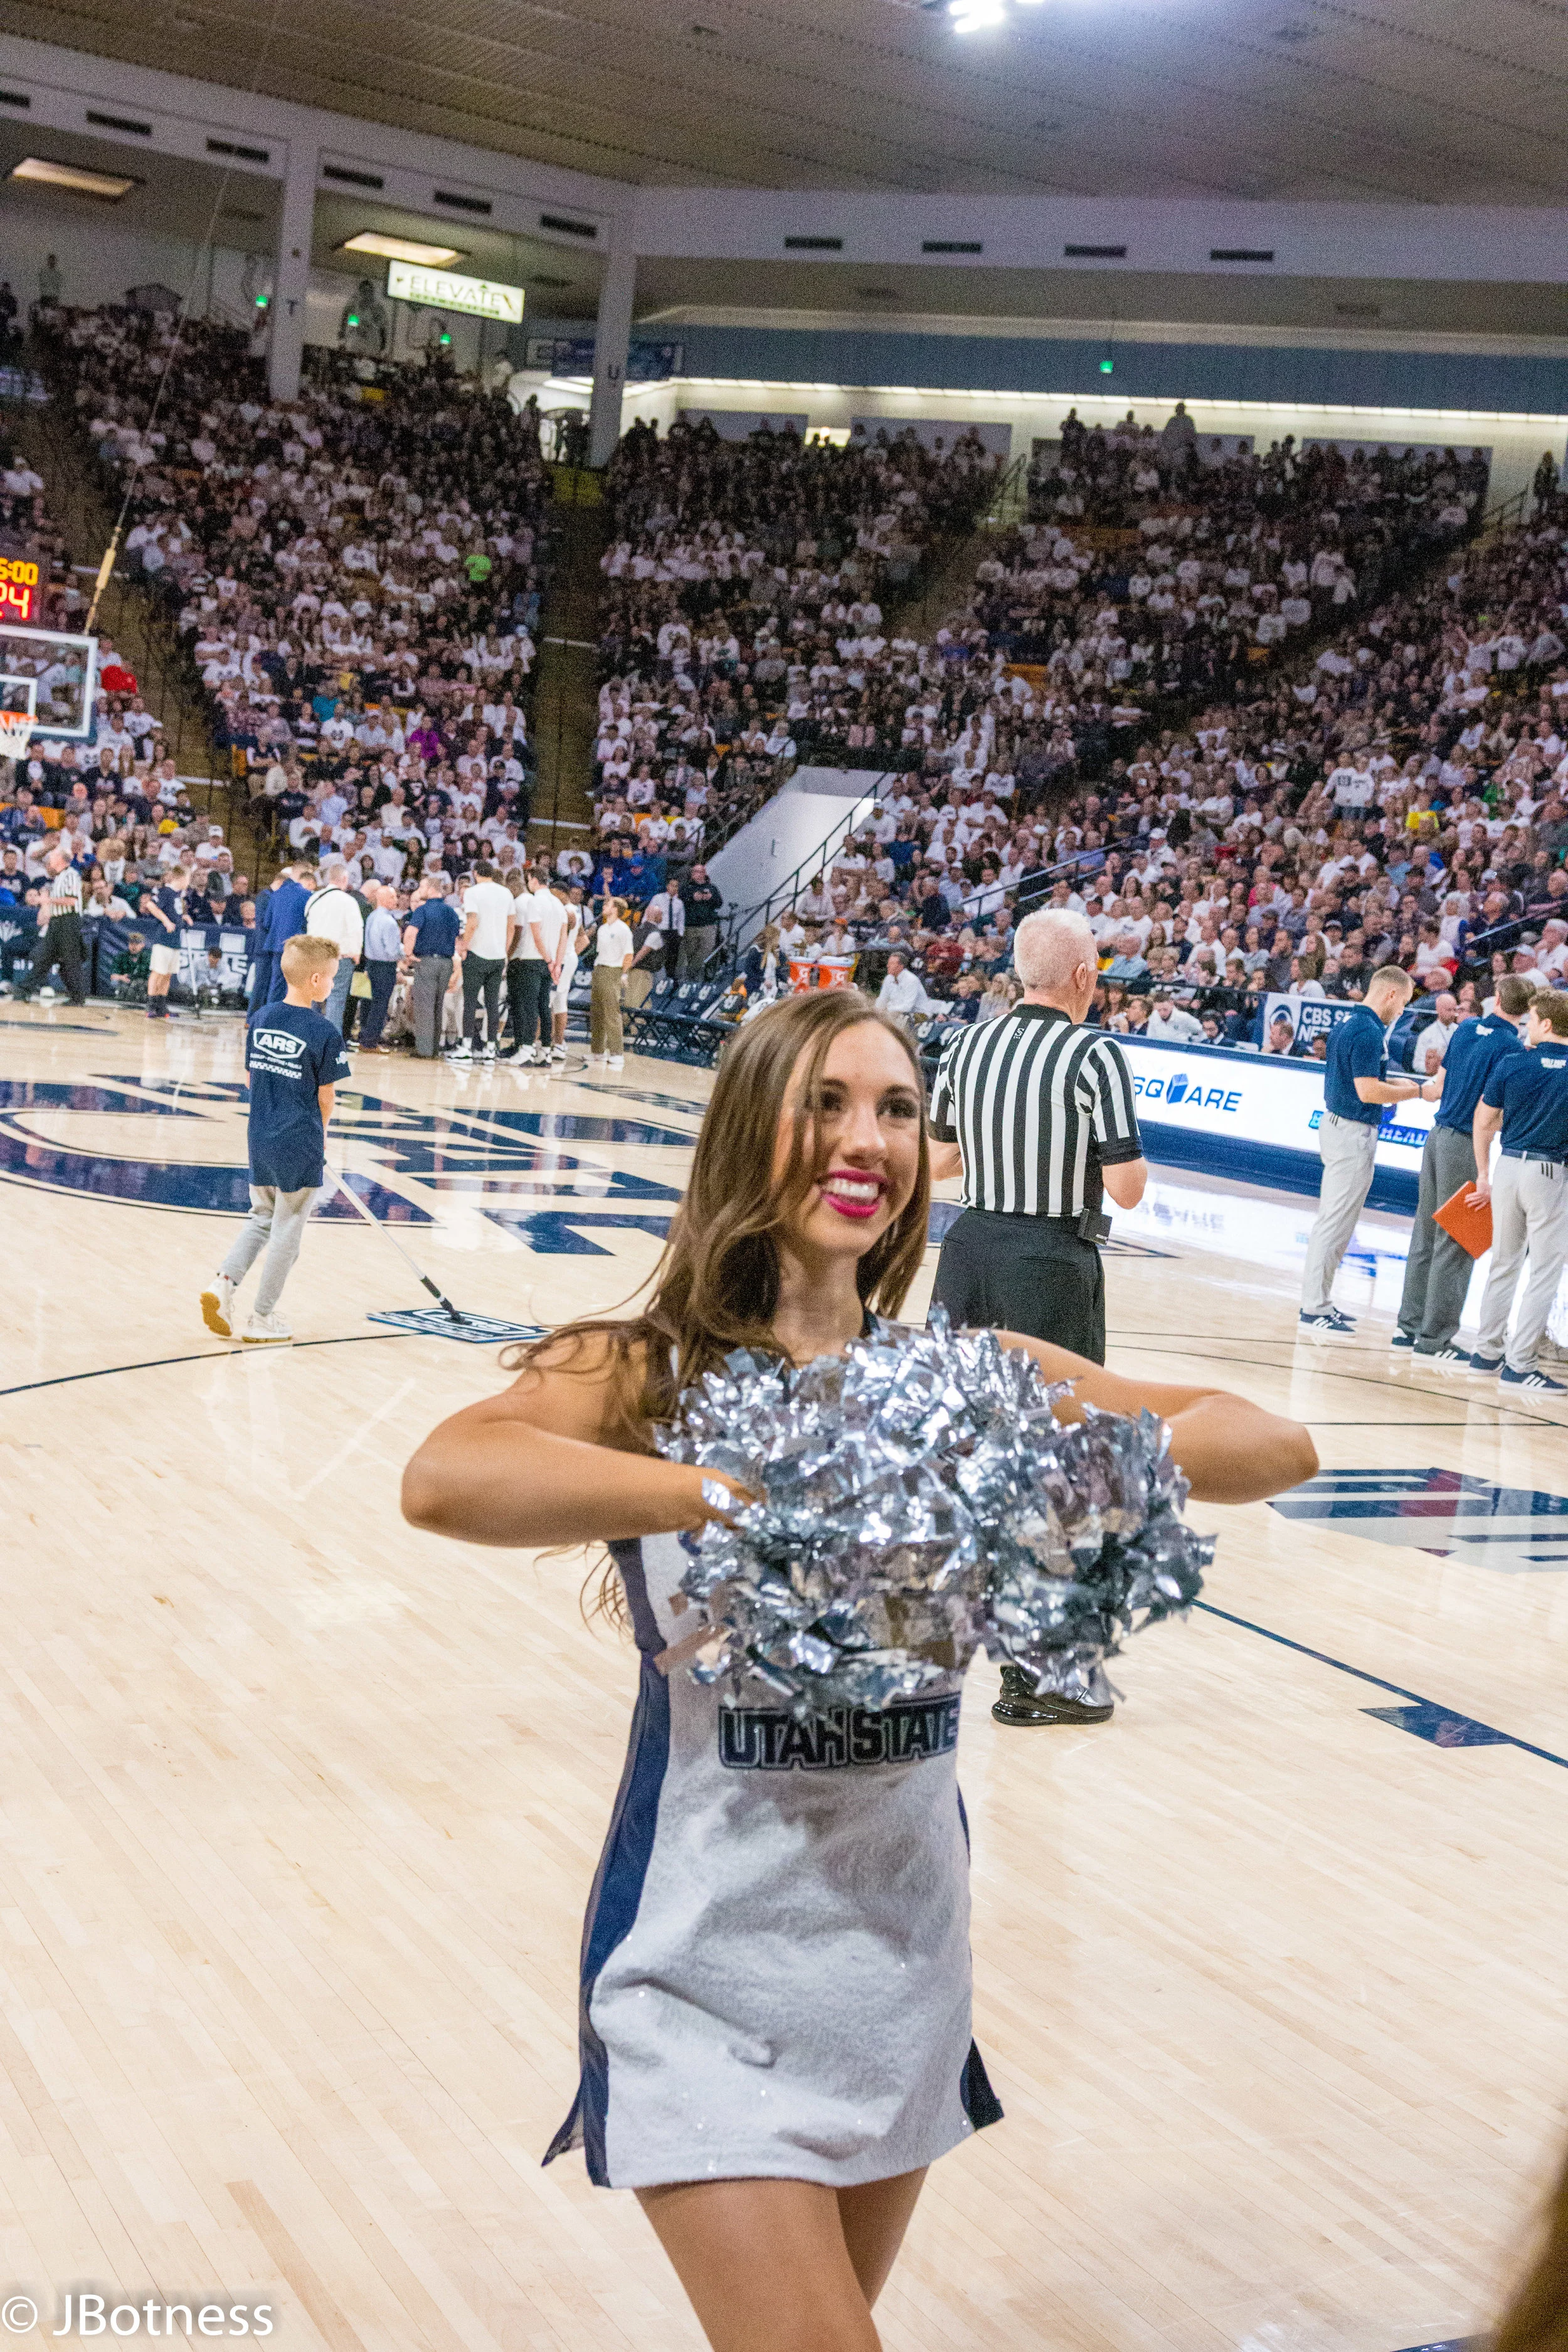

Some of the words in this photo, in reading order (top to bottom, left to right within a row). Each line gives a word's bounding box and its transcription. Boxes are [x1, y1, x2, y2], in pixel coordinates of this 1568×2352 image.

[410, 275, 502, 306] ELEVATE
[1301, 1006, 1332, 1027] CBS
[258, 1034, 297, 1054] ARS
[718, 1705, 849, 1771] UTAH
[849, 1691, 962, 1765] STATE
